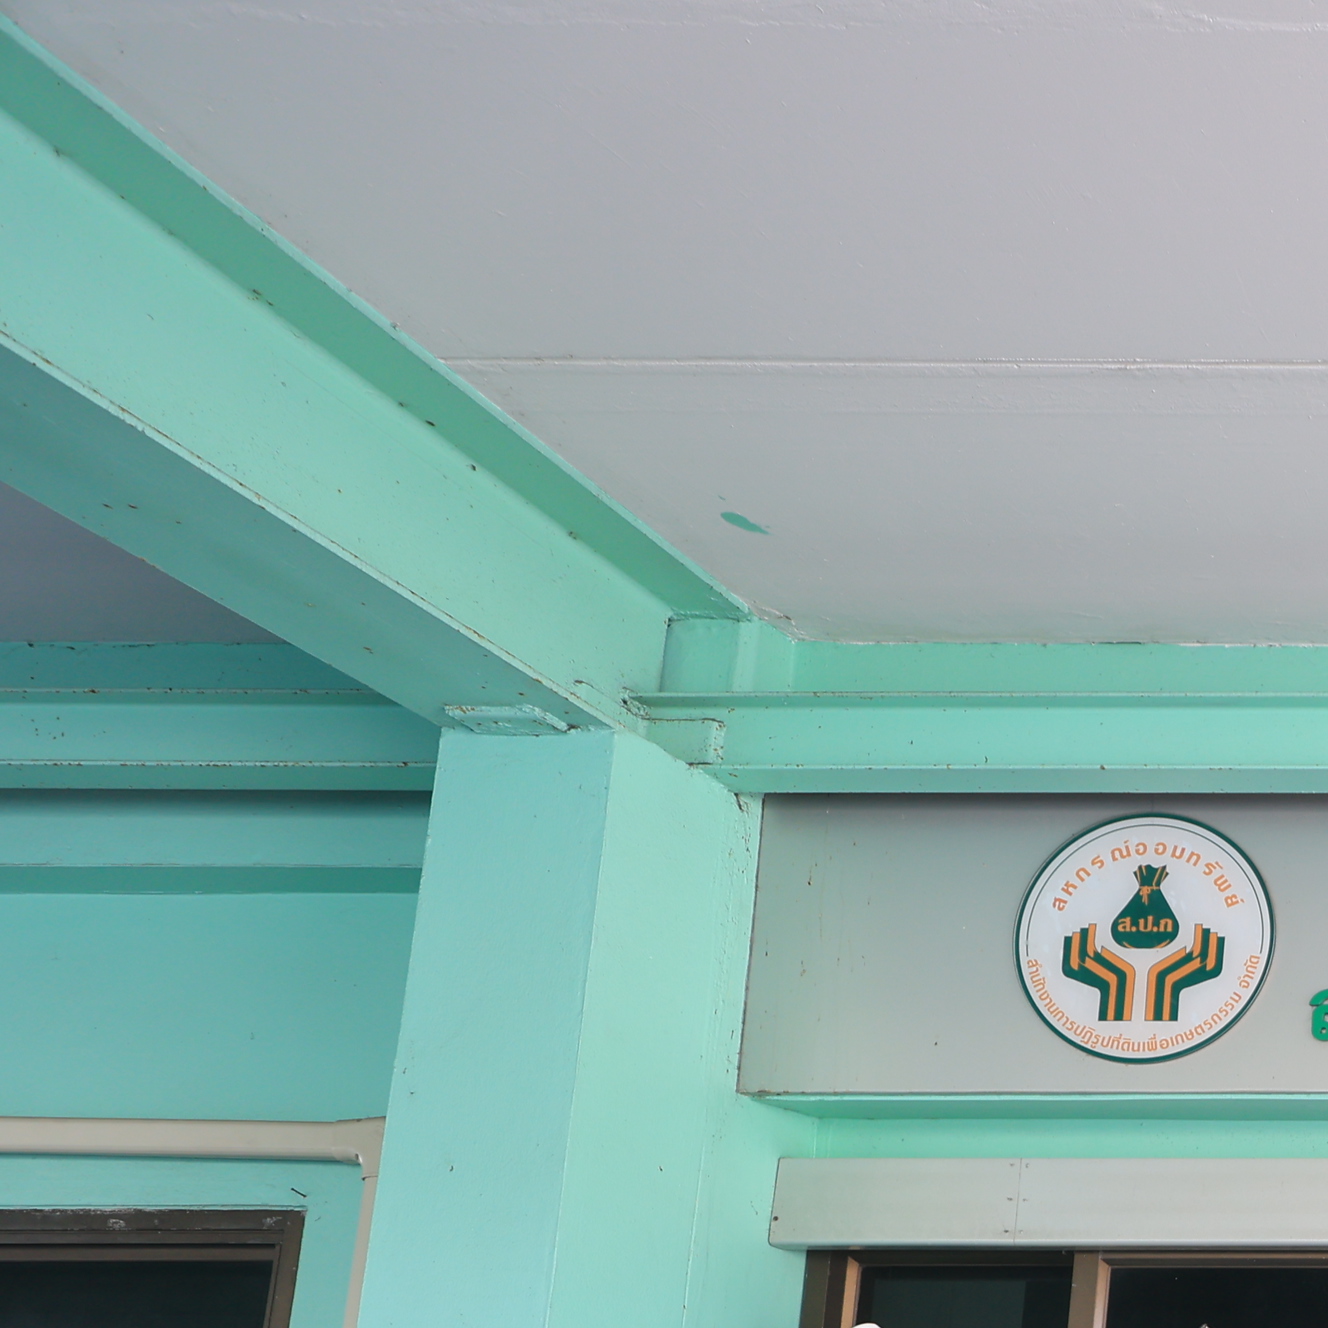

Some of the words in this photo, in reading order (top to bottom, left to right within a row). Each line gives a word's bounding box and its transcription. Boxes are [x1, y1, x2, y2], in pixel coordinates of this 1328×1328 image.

[1052, 840, 1245, 912] สหกรณ์ออมทรัพย์
[1117, 915, 1173, 933] ส.ป.ก
[1237, 953, 1261, 990] จำกัด
